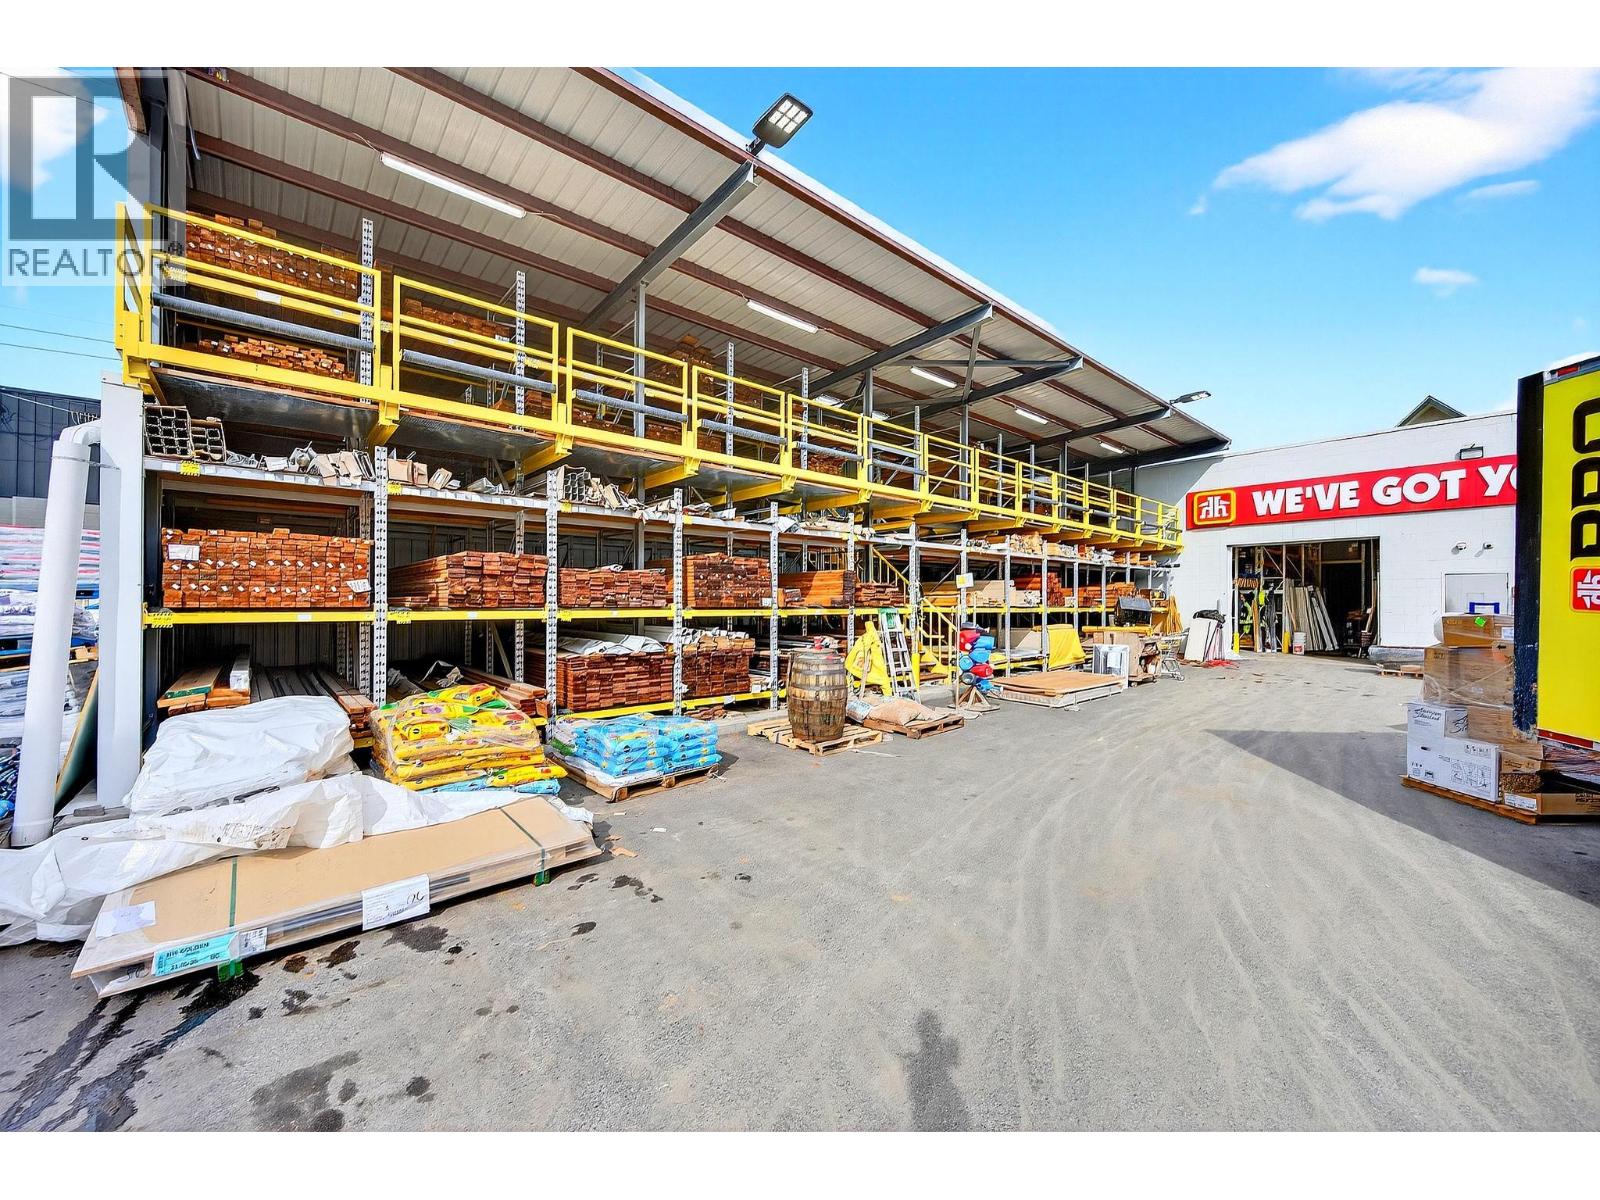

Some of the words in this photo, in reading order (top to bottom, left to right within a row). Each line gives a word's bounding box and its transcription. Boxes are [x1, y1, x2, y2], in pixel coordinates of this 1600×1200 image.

[1252, 480, 1360, 516] WE'VE
[1372, 468, 1467, 505] GOT
[1478, 464, 1517, 498] Y
